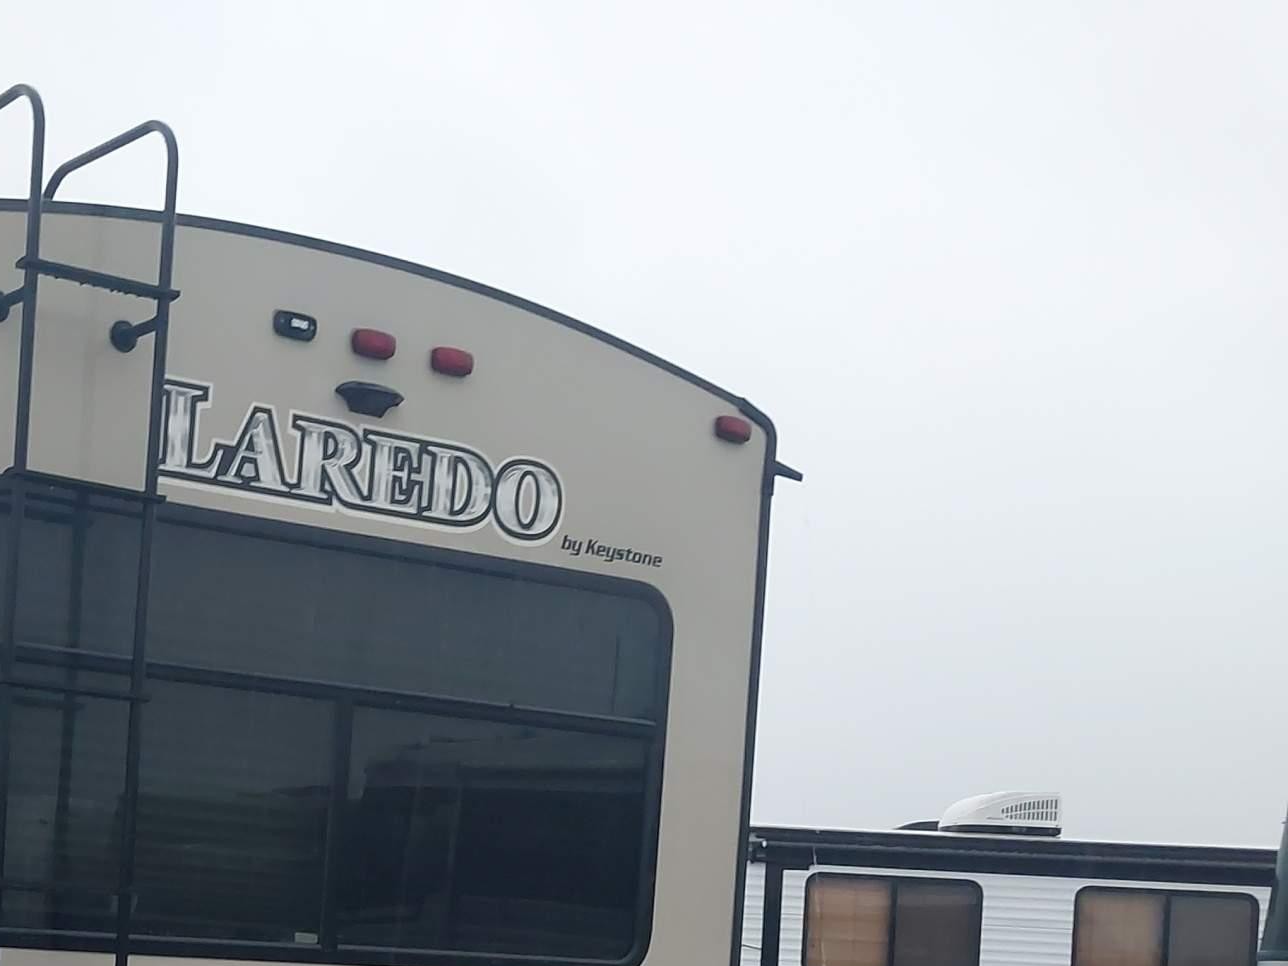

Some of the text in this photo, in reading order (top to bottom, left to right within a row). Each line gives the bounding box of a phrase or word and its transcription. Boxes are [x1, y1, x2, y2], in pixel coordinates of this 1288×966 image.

[158, 378, 564, 543] LAREDO
[560, 534, 663, 568] by Keystone
